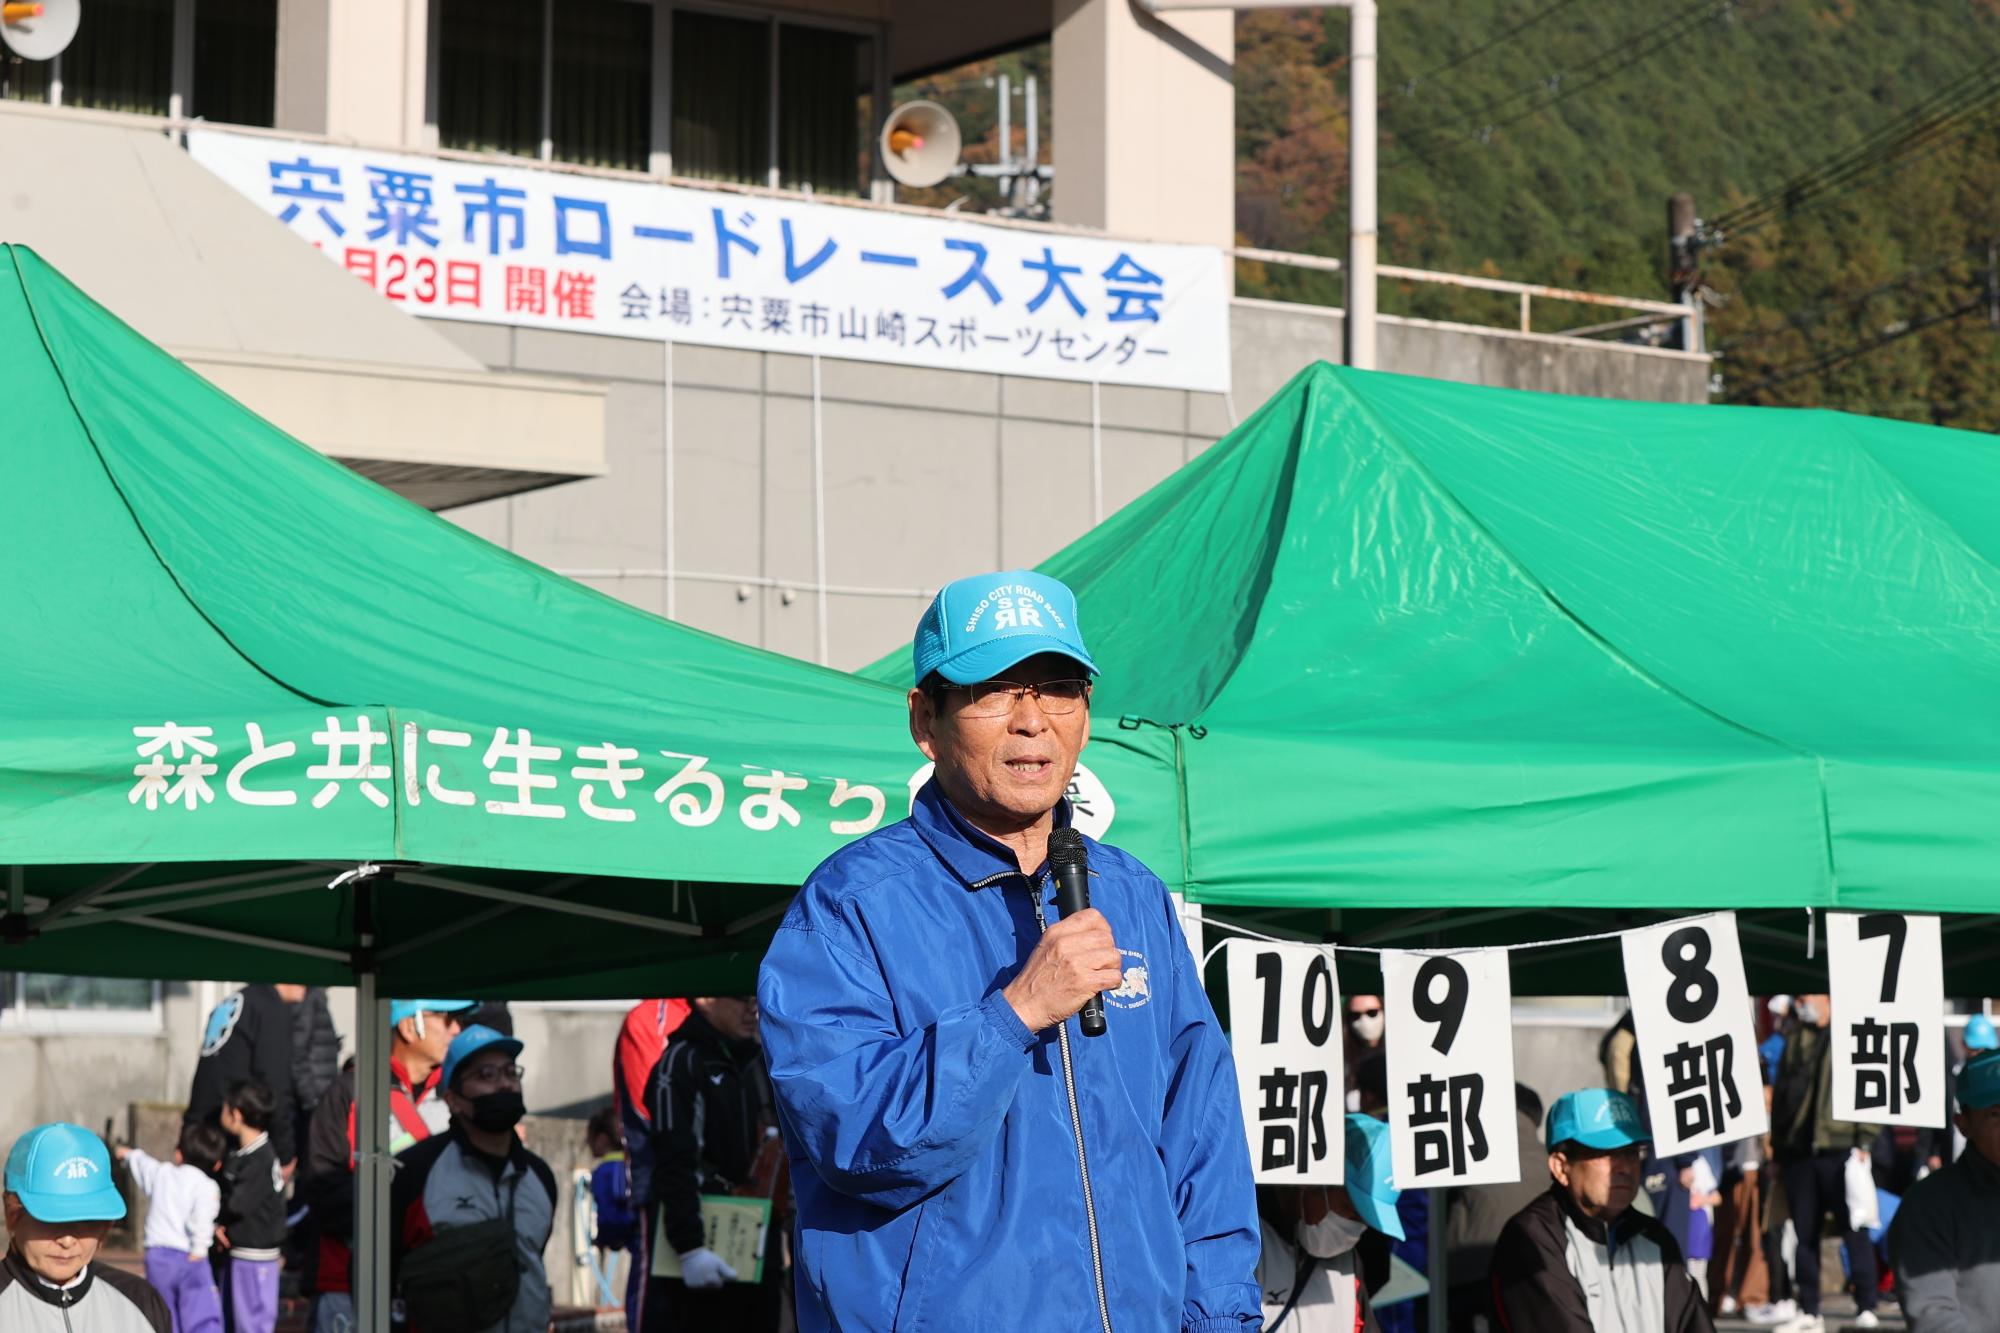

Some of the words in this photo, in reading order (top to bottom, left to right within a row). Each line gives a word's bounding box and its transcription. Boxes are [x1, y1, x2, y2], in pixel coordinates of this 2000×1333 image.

[267, 157, 1165, 324] 宍粟市ロードレース大会
[505, 265, 596, 321] 開催
[965, 599, 989, 632] SHISO
[988, 585, 1013, 601] CITY
[1015, 585, 1045, 604] ROAD
[1044, 602, 1066, 629] RACE
[1255, 952, 1333, 1174] 10部
[1407, 956, 1489, 1177] 9部
[1661, 926, 1742, 1143] 8部
[1851, 914, 1920, 1115] 7部
